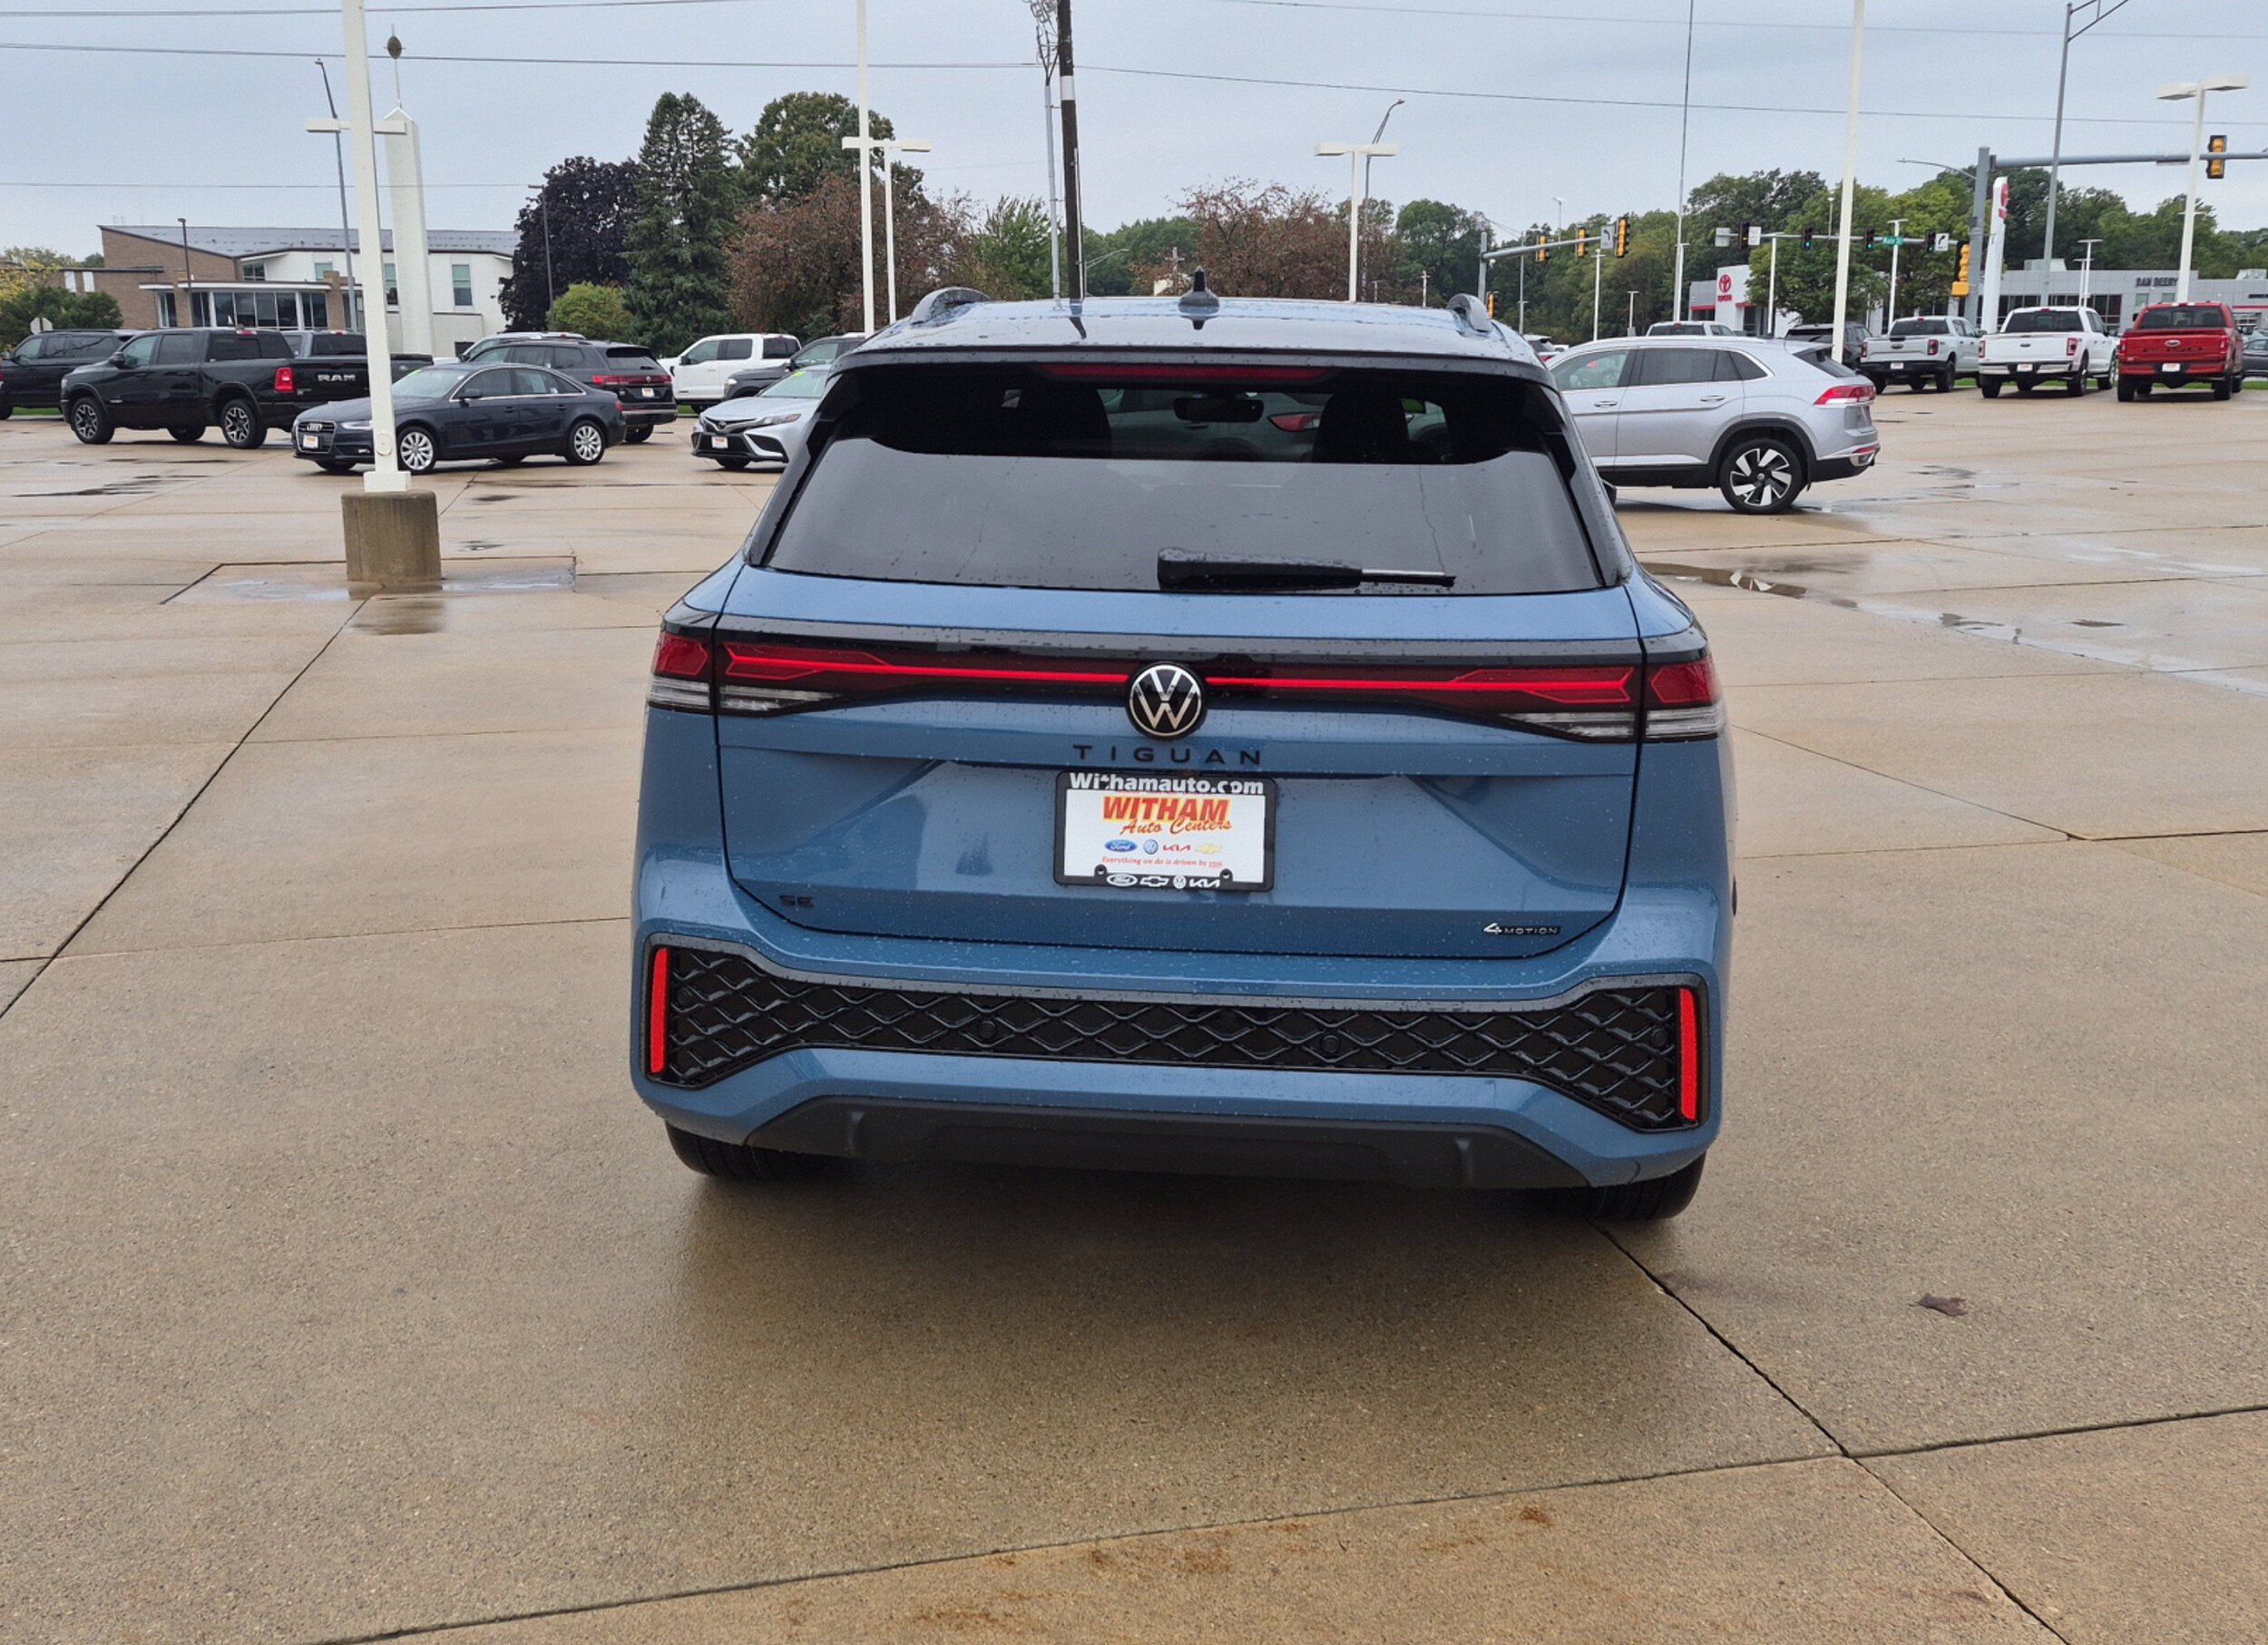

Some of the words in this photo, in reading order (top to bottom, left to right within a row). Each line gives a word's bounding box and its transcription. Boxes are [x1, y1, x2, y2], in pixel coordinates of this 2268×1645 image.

[317, 374, 356, 382] RAM
[1072, 744, 1262, 766] TIGUAN
[1102, 796, 1229, 822] WITHAM
[1119, 820, 1163, 836] Auto
[1169, 818, 1233, 835] Centers
[779, 894, 814, 908] SE
[1483, 922, 1558, 935] 4MOTION
